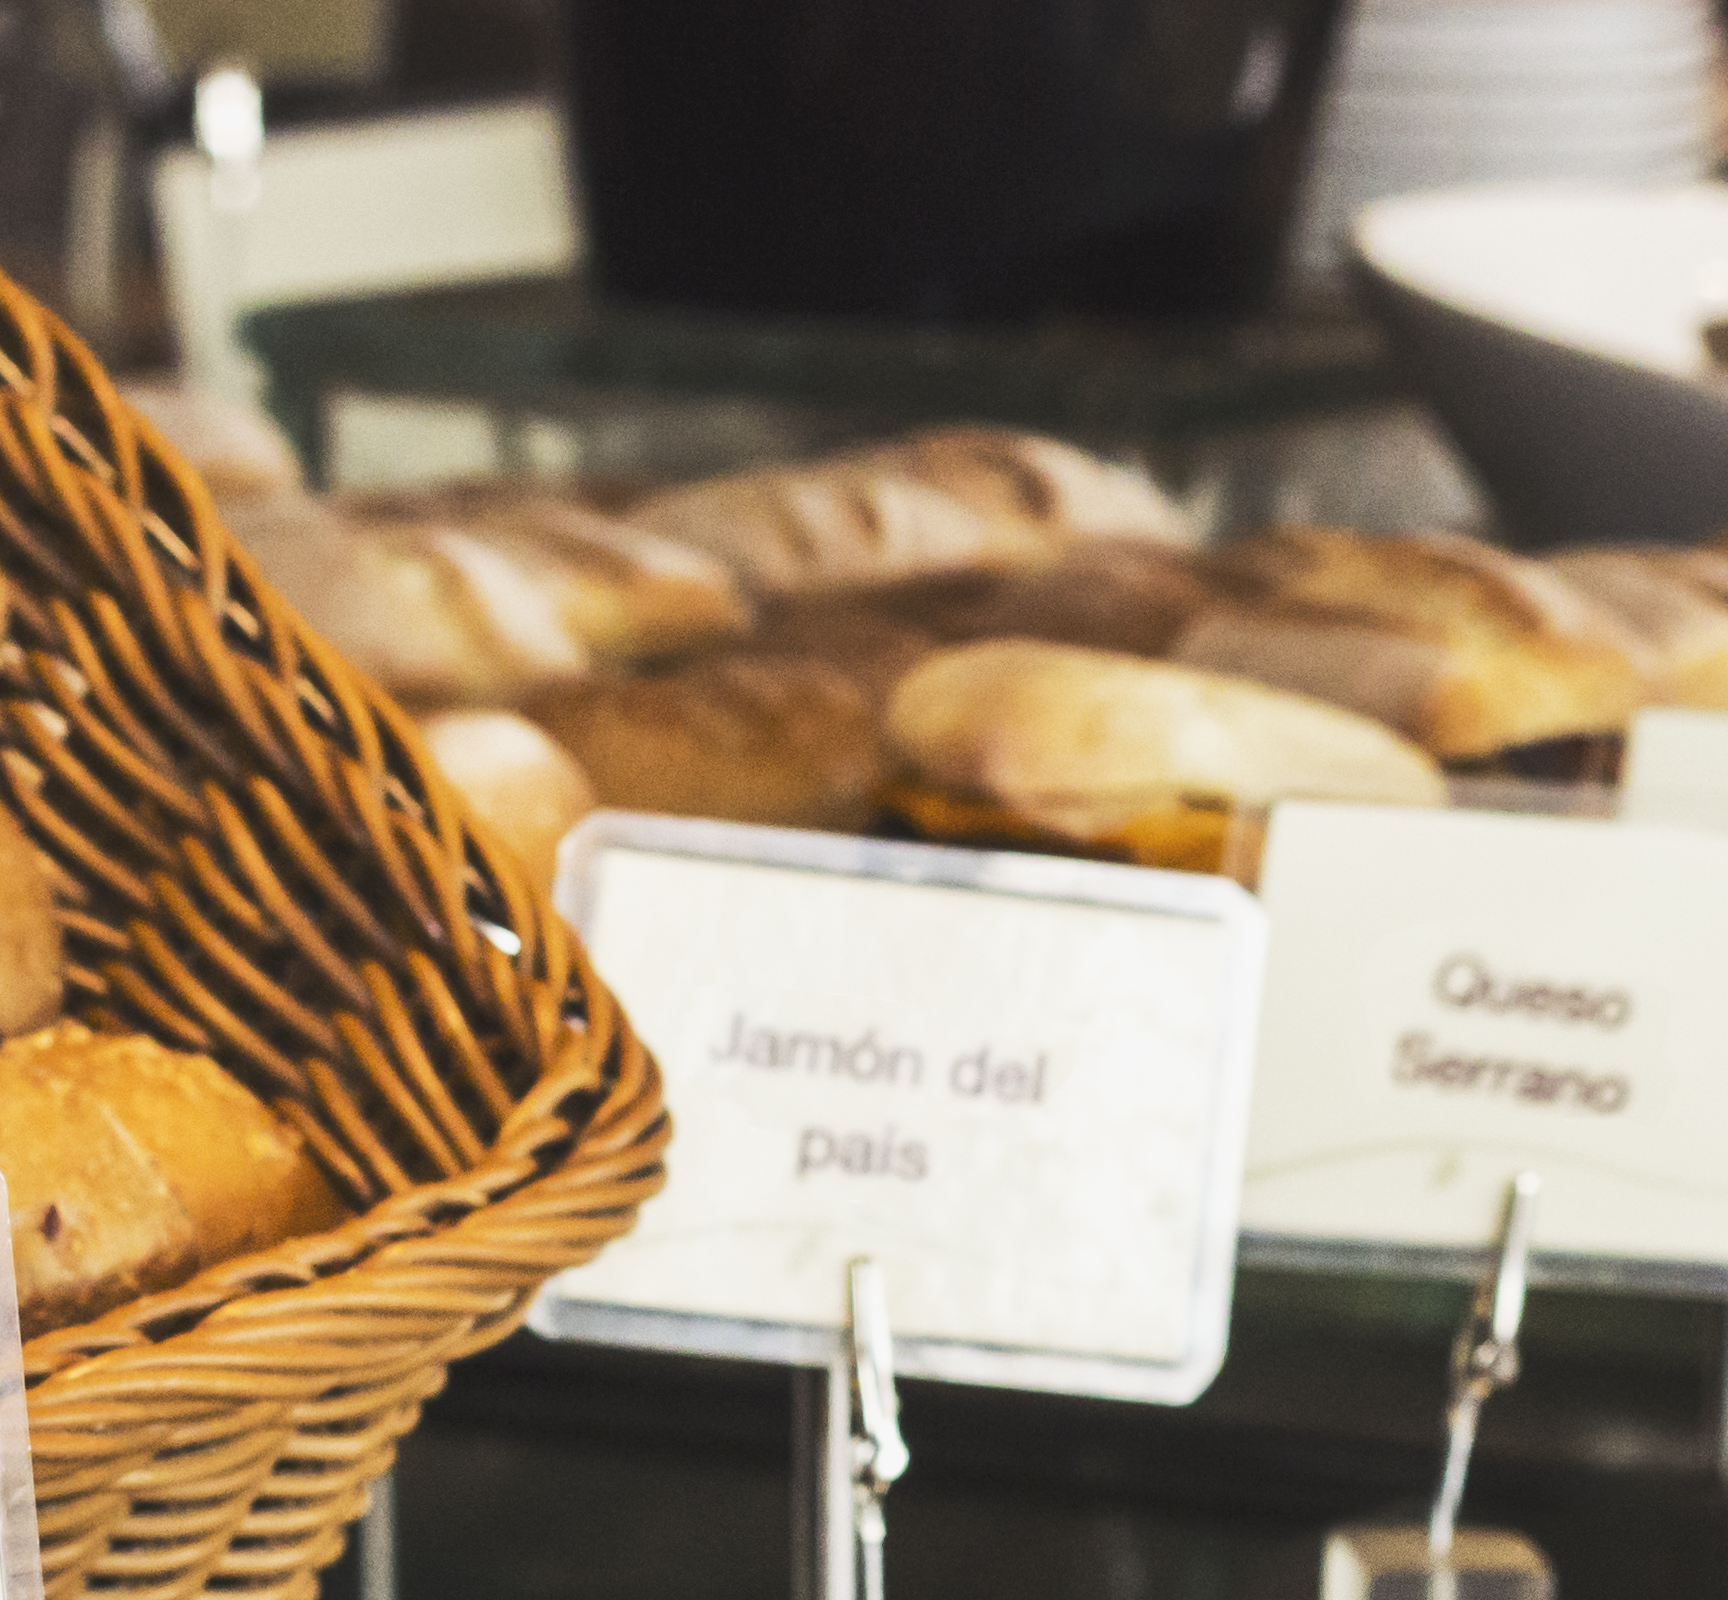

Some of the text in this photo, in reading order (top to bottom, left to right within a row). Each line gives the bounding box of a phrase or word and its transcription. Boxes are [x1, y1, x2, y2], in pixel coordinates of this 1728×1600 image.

[1432, 952, 1632, 1030] Queso
[710, 1012, 1048, 1105] Jamón del
[1392, 1030, 1630, 1115] Serrano
